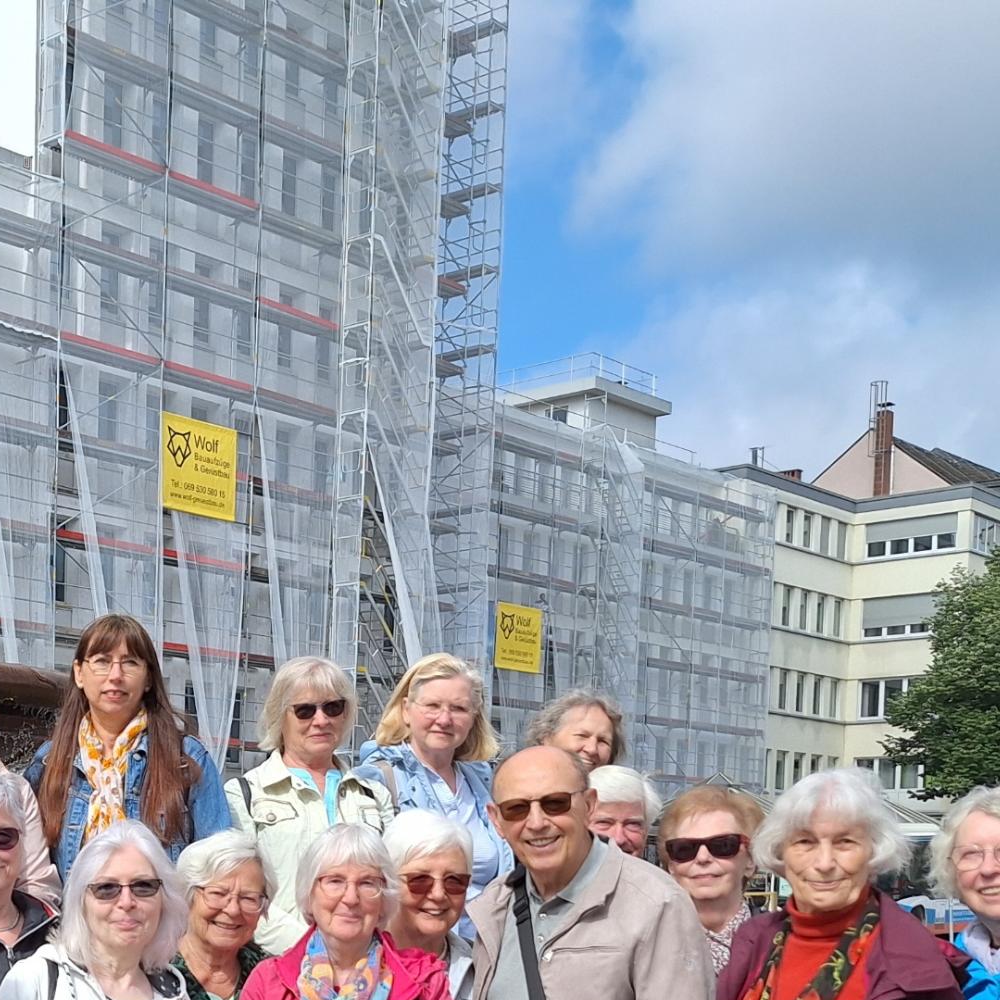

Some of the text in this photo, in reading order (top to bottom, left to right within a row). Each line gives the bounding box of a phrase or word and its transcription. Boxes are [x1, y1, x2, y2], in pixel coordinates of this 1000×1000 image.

[193, 433, 219, 453] Wolf
[193, 463, 199, 472] &
[516, 615, 531, 627] Wolf
